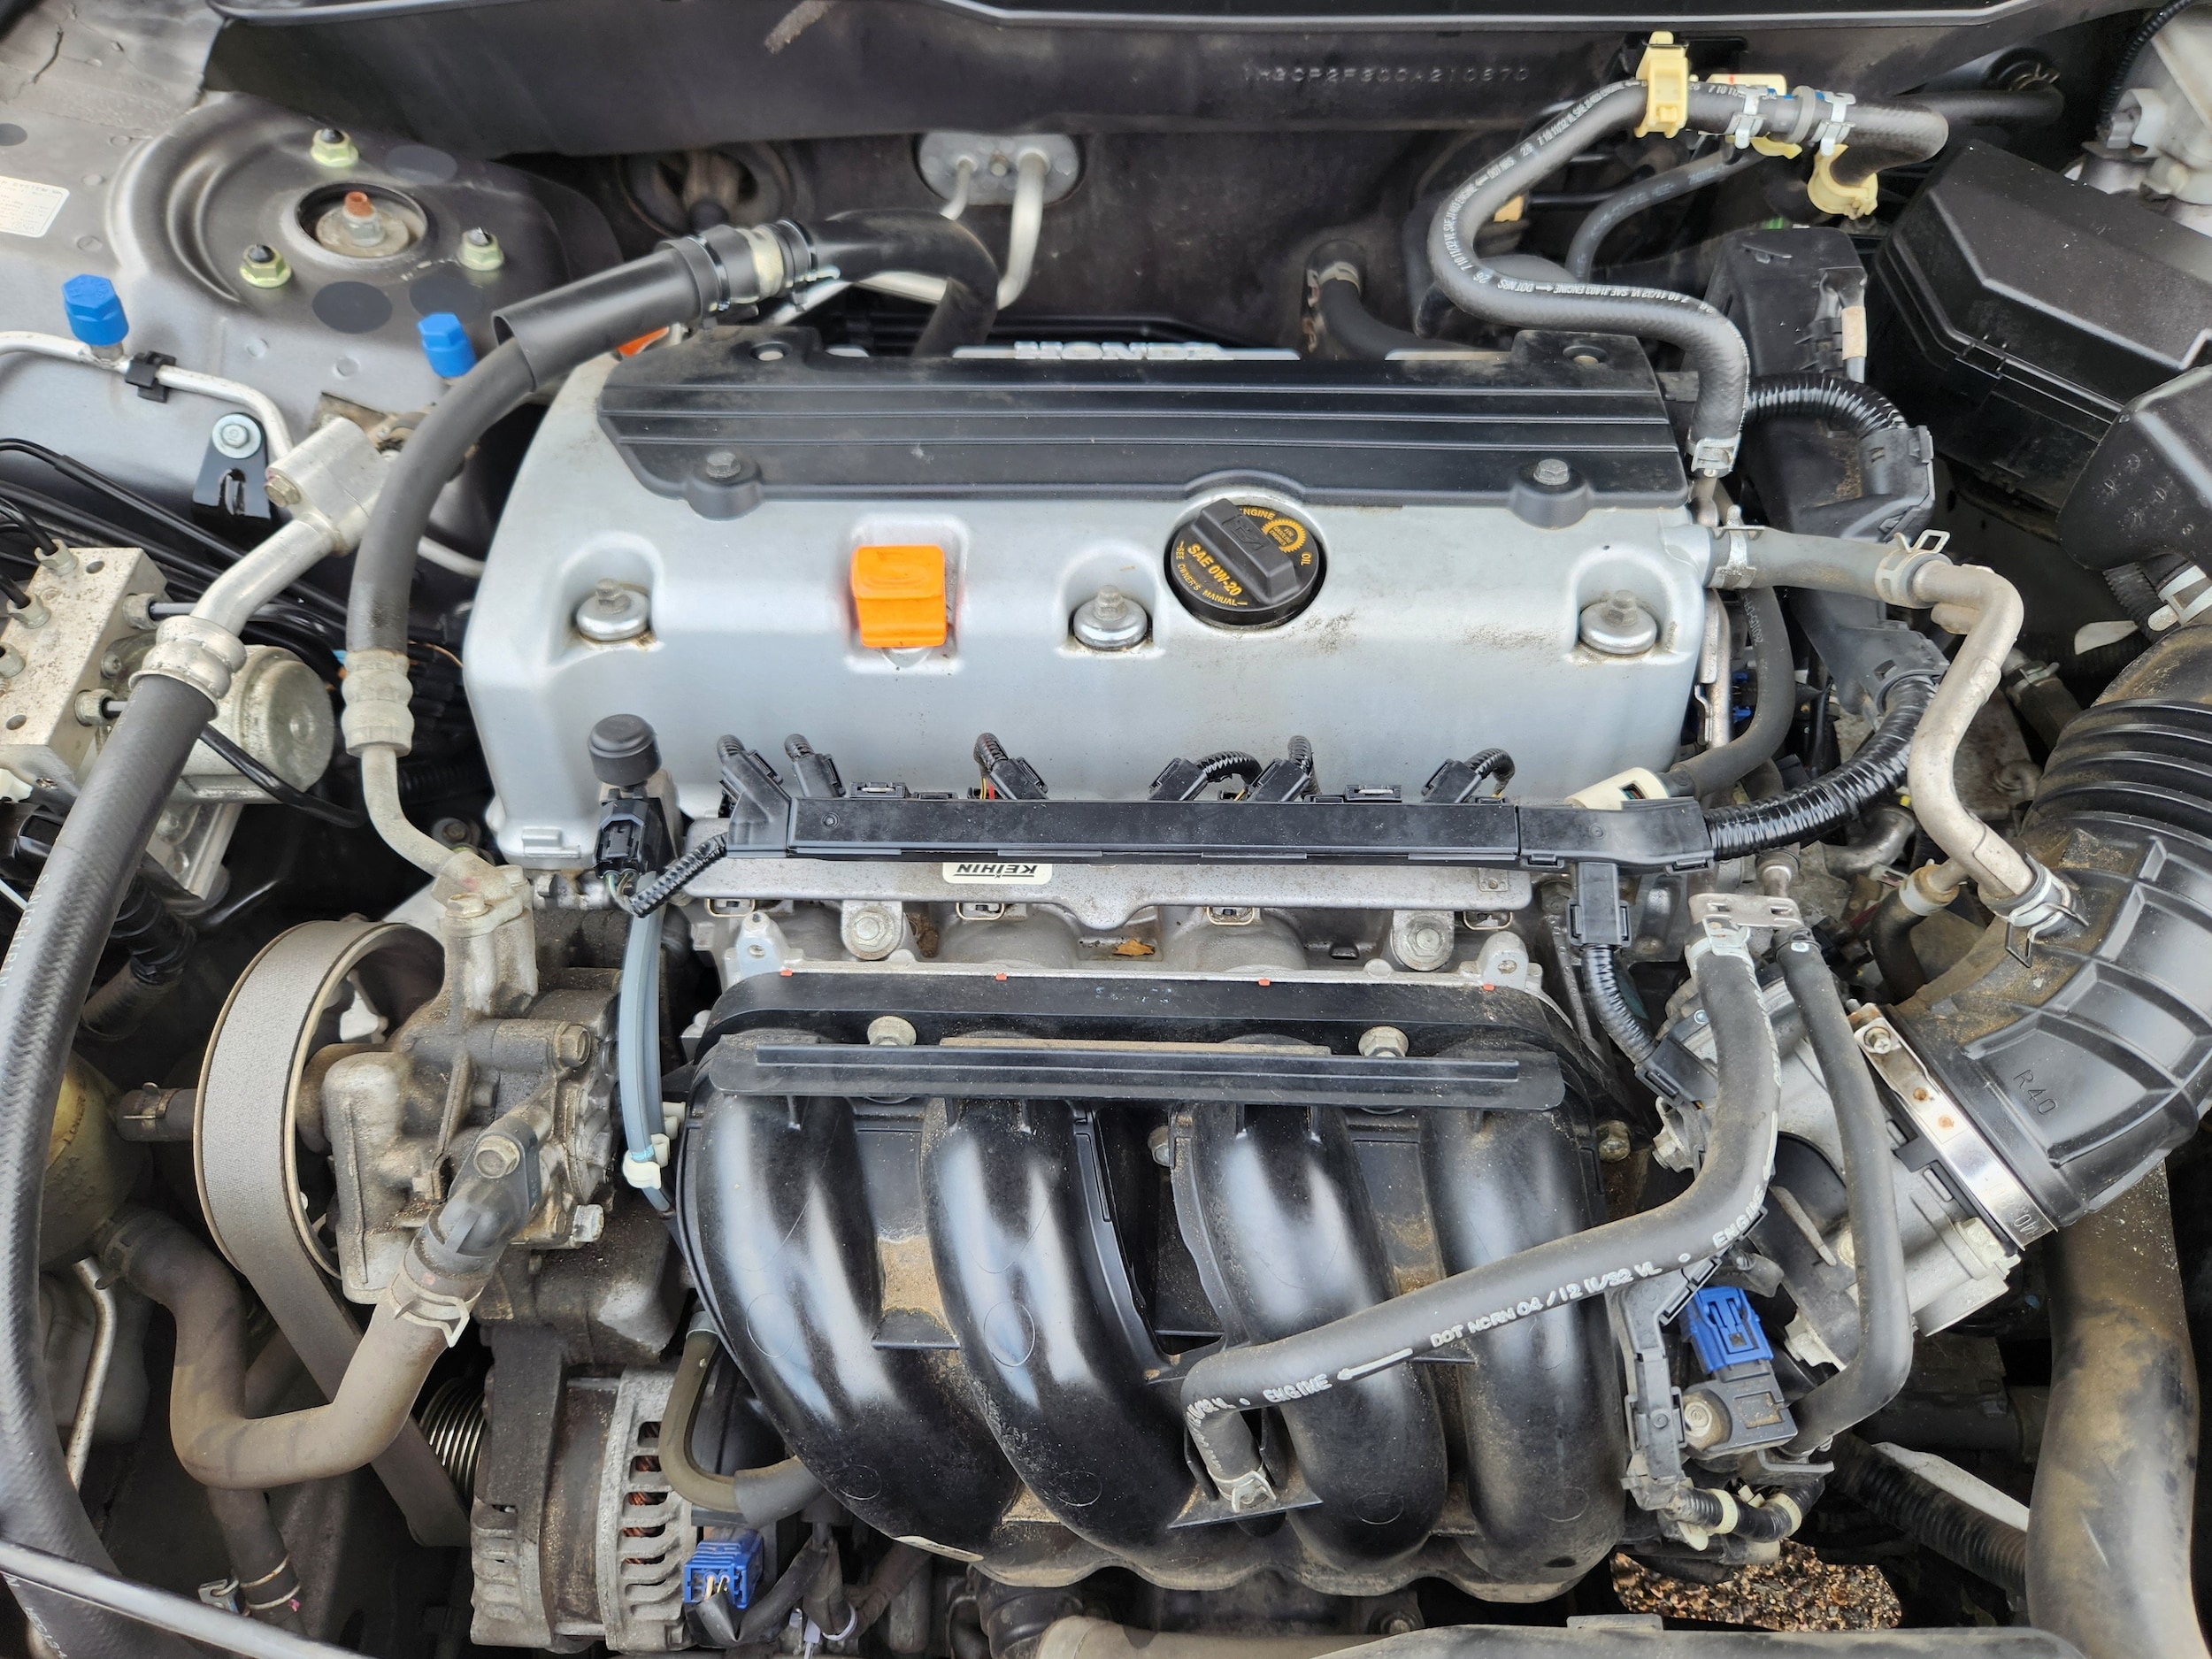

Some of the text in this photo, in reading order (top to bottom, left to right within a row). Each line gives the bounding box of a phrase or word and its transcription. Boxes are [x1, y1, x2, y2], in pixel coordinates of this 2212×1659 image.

[1514, 281, 1535, 293] DOT
[1554, 282, 1586, 296] ENGINE
[1014, 341, 1233, 361] HONDA
[1239, 507, 1312, 566] NGINE OIL
[1177, 564, 1202, 591] OWNER'S
[1202, 589, 1238, 607] MANUAL
[1187, 543, 1243, 596] SAE 0W-20
[956, 864, 1038, 876] KEIHIN
[2013, 1069, 2058, 1116] R40
[1263, 1373, 1333, 1403] ENGINE
[1429, 1325, 1464, 1349] DOT
[1467, 1307, 1518, 1335] NCRN
[1633, 1261, 1663, 1279] VL
[1712, 1184, 1764, 1249] ENGINE
